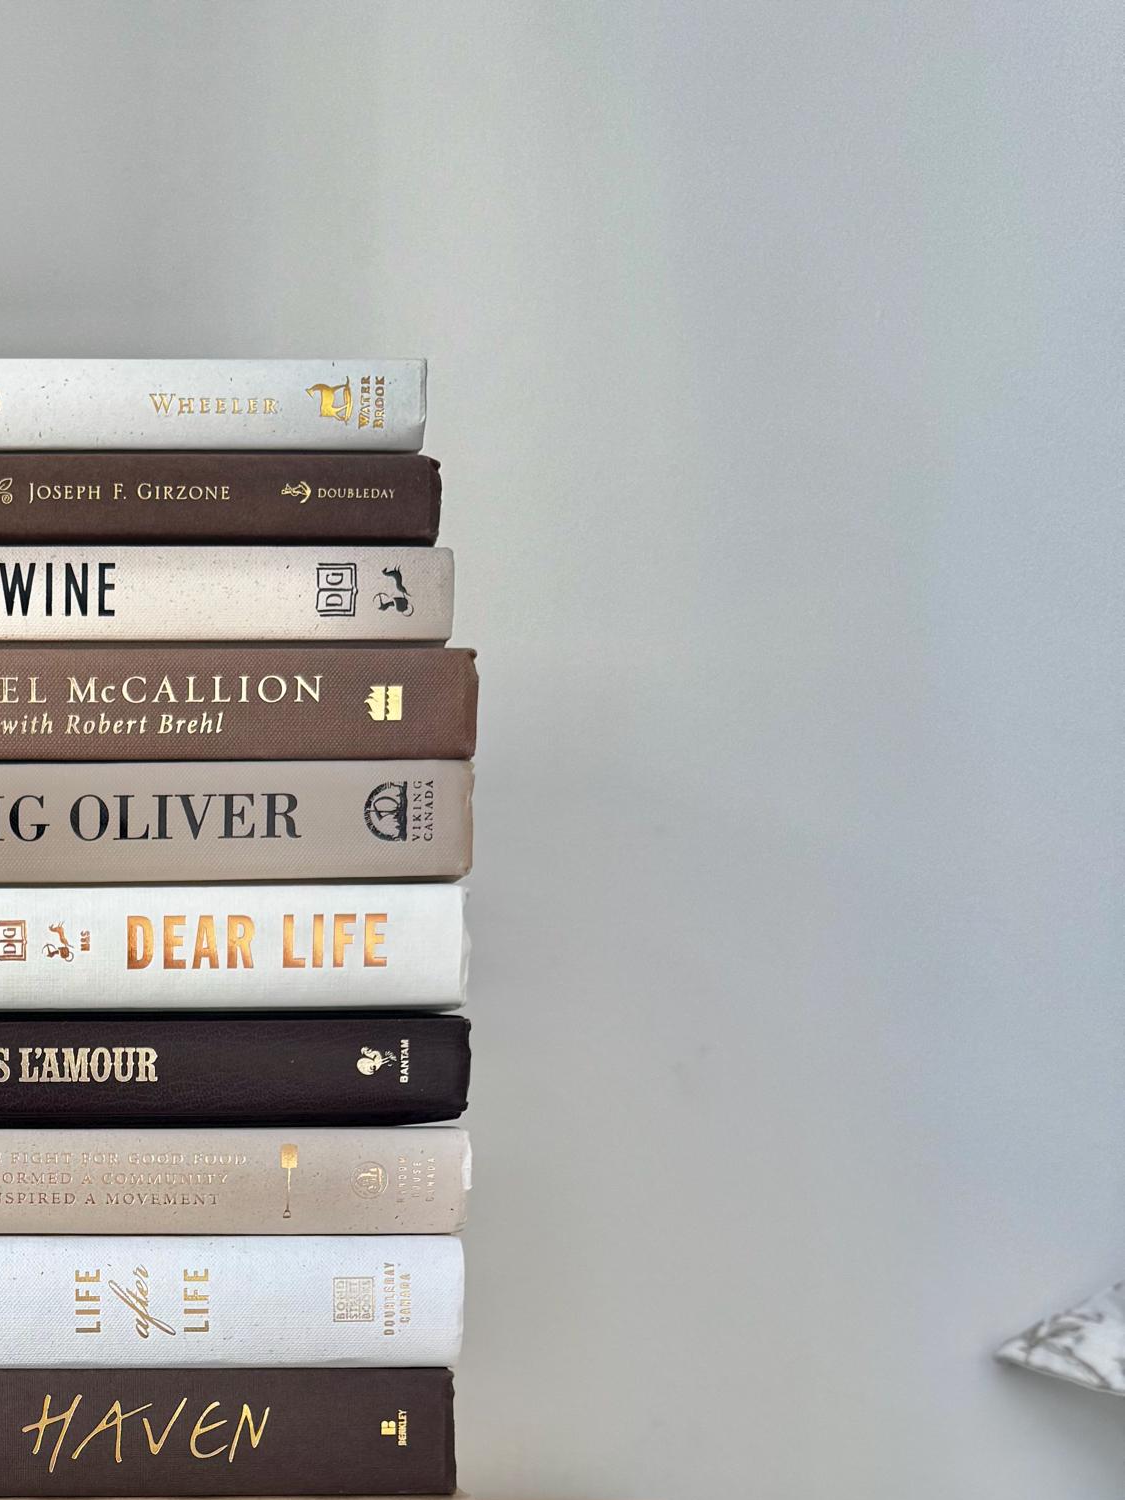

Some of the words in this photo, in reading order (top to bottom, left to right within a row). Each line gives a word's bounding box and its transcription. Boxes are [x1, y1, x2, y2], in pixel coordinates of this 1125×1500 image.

[149, 393, 278, 416] WHEELER
[358, 376, 370, 429] WATER
[373, 376, 384, 428] BROOK
[28, 482, 101, 504] JOSEPH
[113, 483, 128, 500] F.
[137, 482, 231, 501] GIRZONE
[317, 487, 396, 499] DOUBLEDAY
[0, 562, 116, 617] WINE
[67, 675, 323, 704] McCALLION
[0, 713, 53, 735] with
[65, 713, 147, 735] Robert
[158, 712, 224, 734] Brehl
[69, 793, 302, 842] OLIVER
[412, 781, 422, 841] VIKING
[424, 780, 434, 841] CANADA
[127, 914, 256, 970] DEAR
[283, 913, 388, 968] LIFE
[18, 1047, 158, 1083] L'AMOUR
[399, 1039, 410, 1084] BANTAM
[11, 1152, 73, 1165] FIGHT
[82, 1152, 119, 1165] FOR
[128, 1152, 184, 1165] GOOD
[194, 1152, 247, 1166] FOOD
[81, 1173, 93, 1184] A
[102, 1172, 228, 1185] COMMUNITY
[84, 1193, 96, 1205] A
[106, 1193, 219, 1205] MOVEMENT
[75, 1268, 101, 1334] LIFE
[108, 1264, 176, 1339] after
[183, 1268, 210, 1334] LIFE
[383, 1262, 395, 1335] DOUBLEDAY
[399, 1273, 411, 1323] CANADA
[22, 1394, 270, 1473] HAVEN
[398, 1409, 407, 1446] BERKLEY
